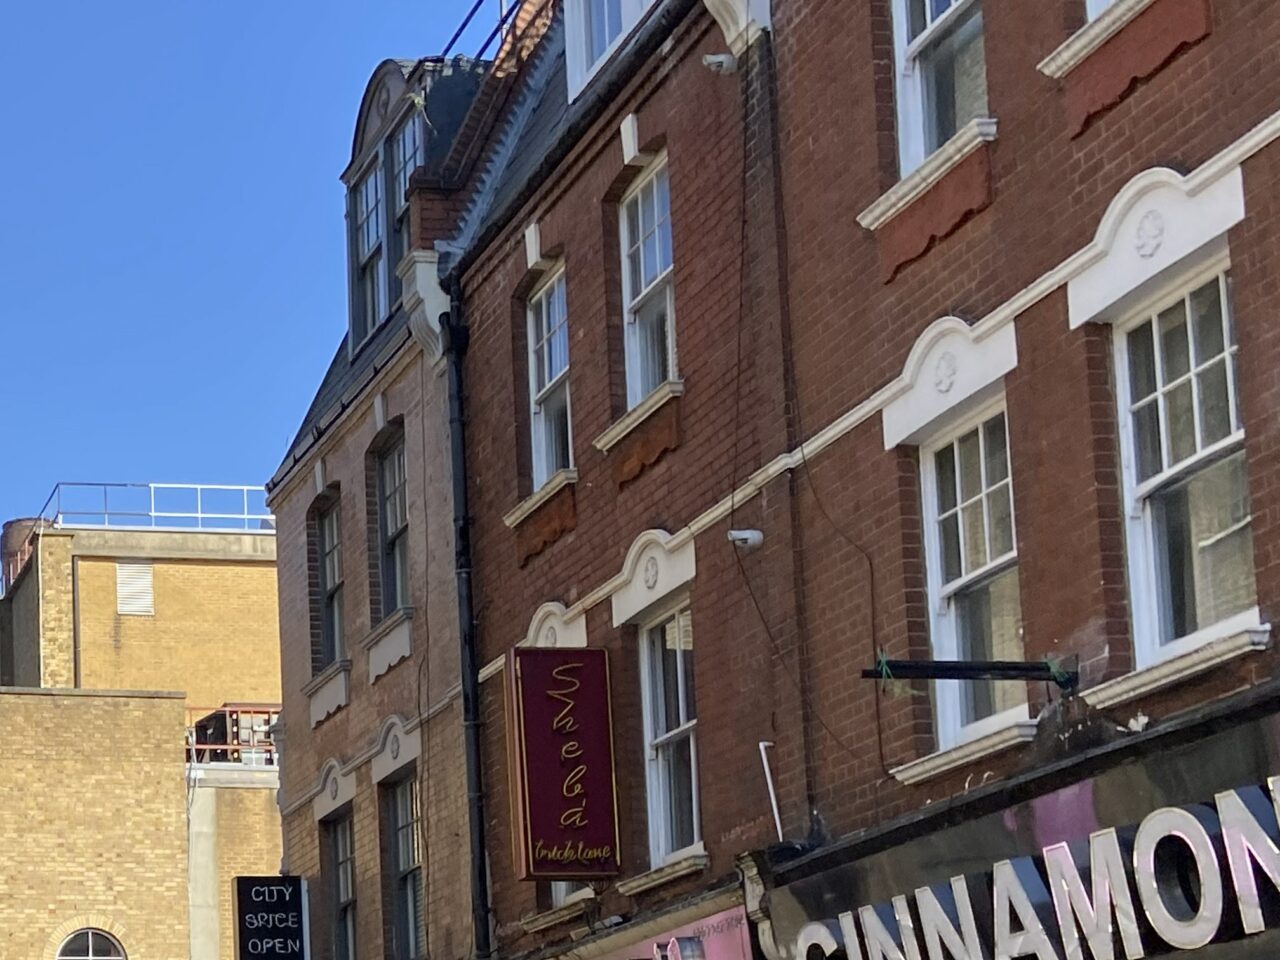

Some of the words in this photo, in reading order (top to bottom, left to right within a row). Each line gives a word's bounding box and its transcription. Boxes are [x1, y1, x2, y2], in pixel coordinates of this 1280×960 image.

[546, 663, 588, 828] Sheba
[251, 886, 293, 902] CITY
[245, 912, 299, 928] SPICE
[248, 939, 300, 954] OPEN
